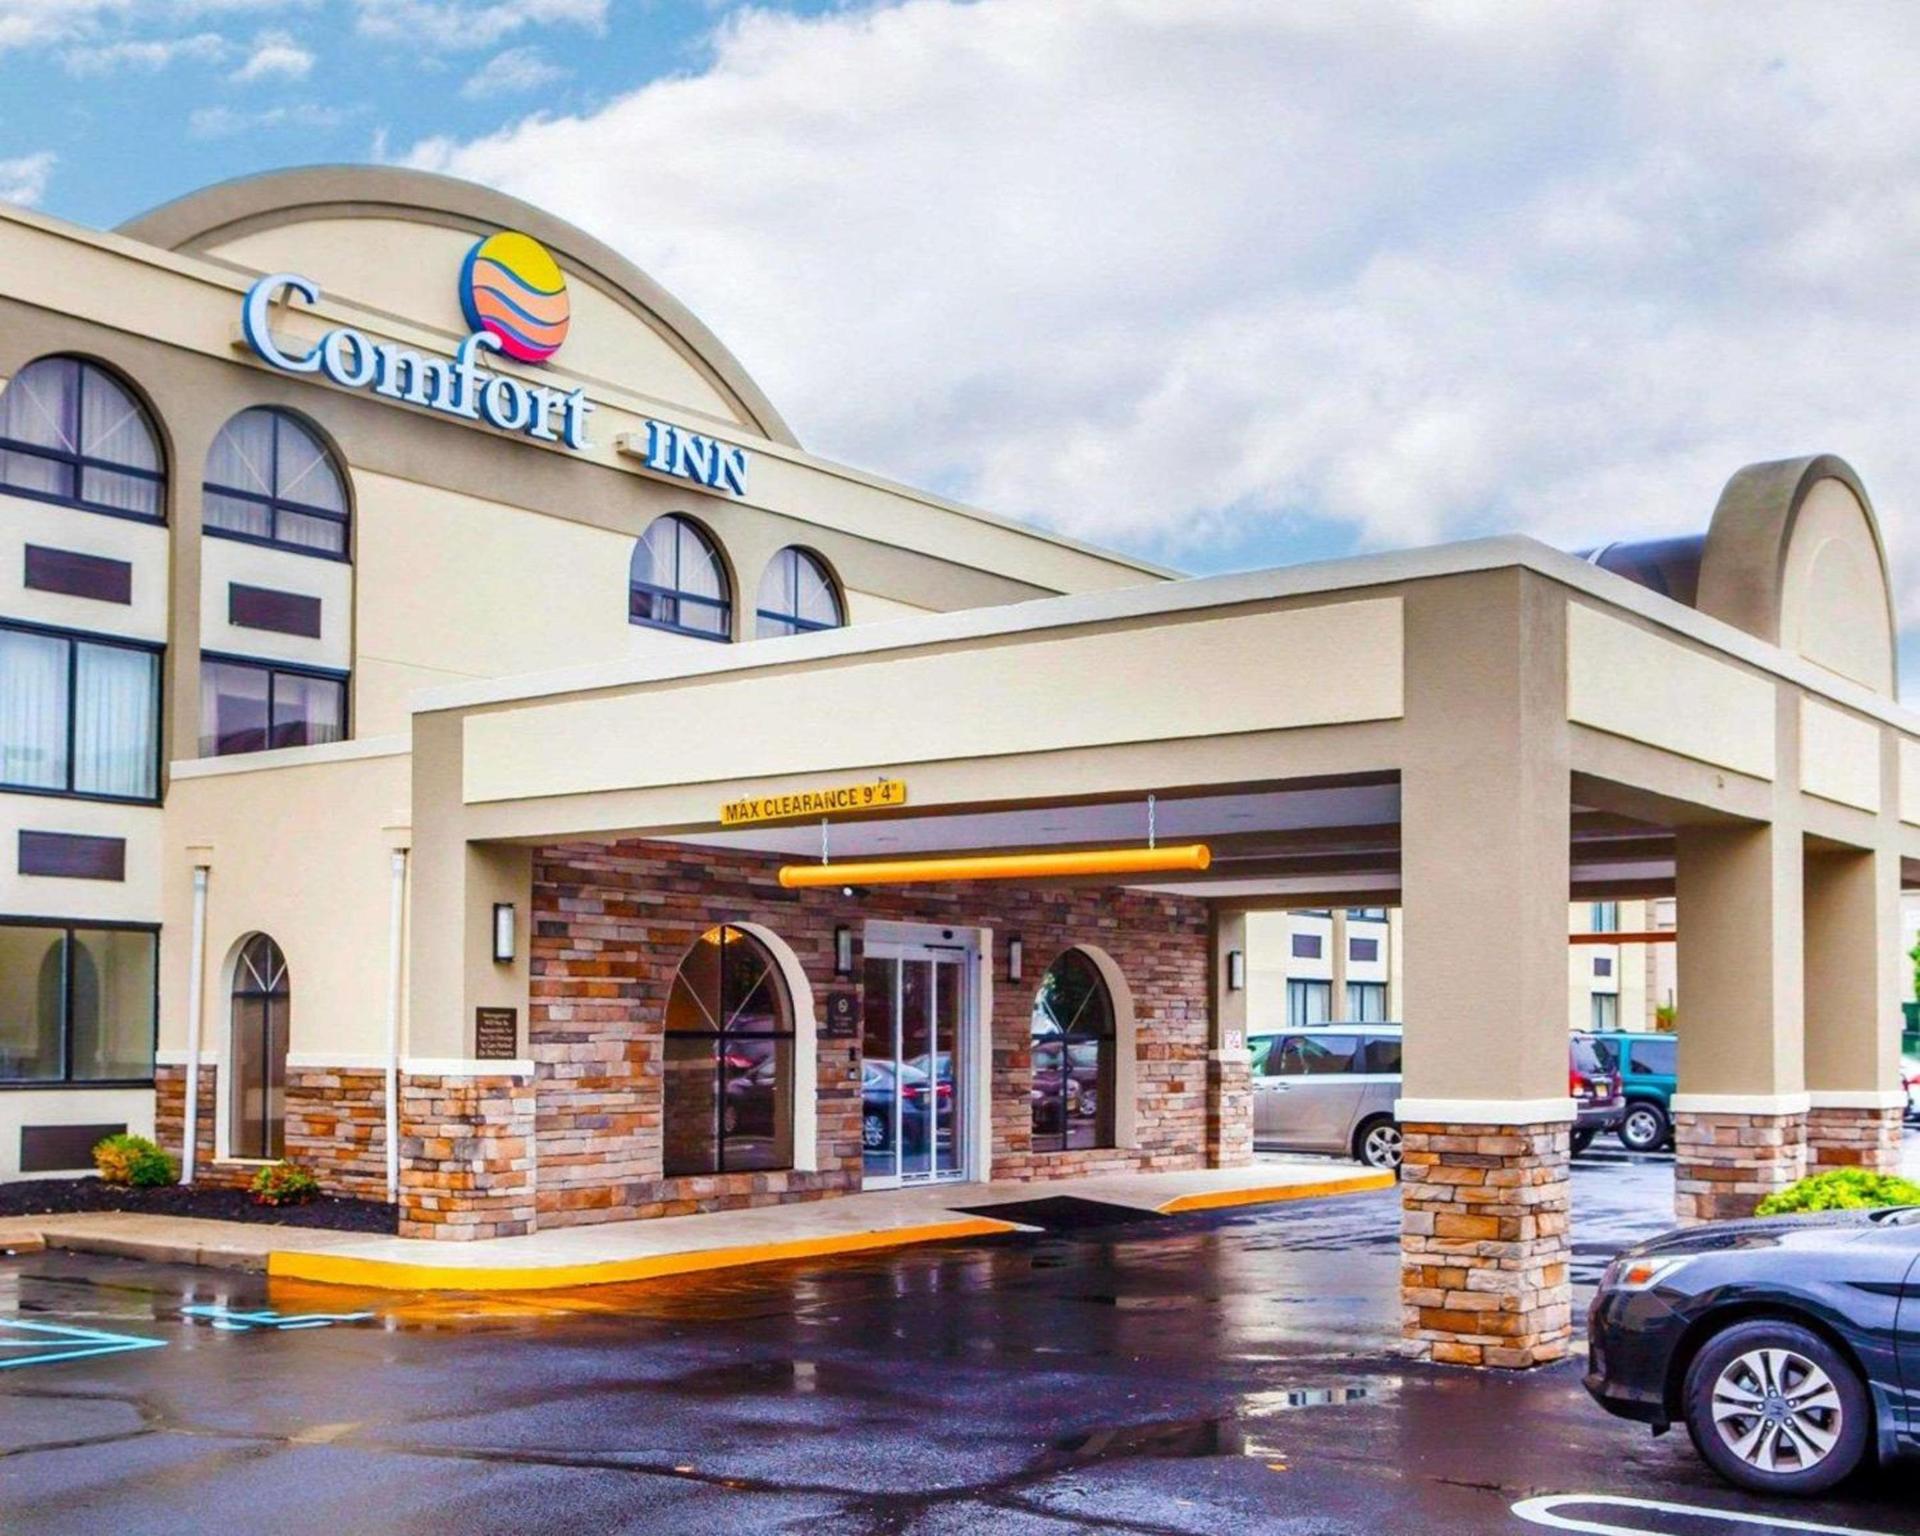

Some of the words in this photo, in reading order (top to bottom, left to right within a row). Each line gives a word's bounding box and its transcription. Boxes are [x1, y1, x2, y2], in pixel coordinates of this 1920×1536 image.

[242, 273, 596, 450] Comfort
[645, 419, 751, 496] INN
[726, 802, 760, 821] MAX
[764, 788, 858, 816] CLEARANCE
